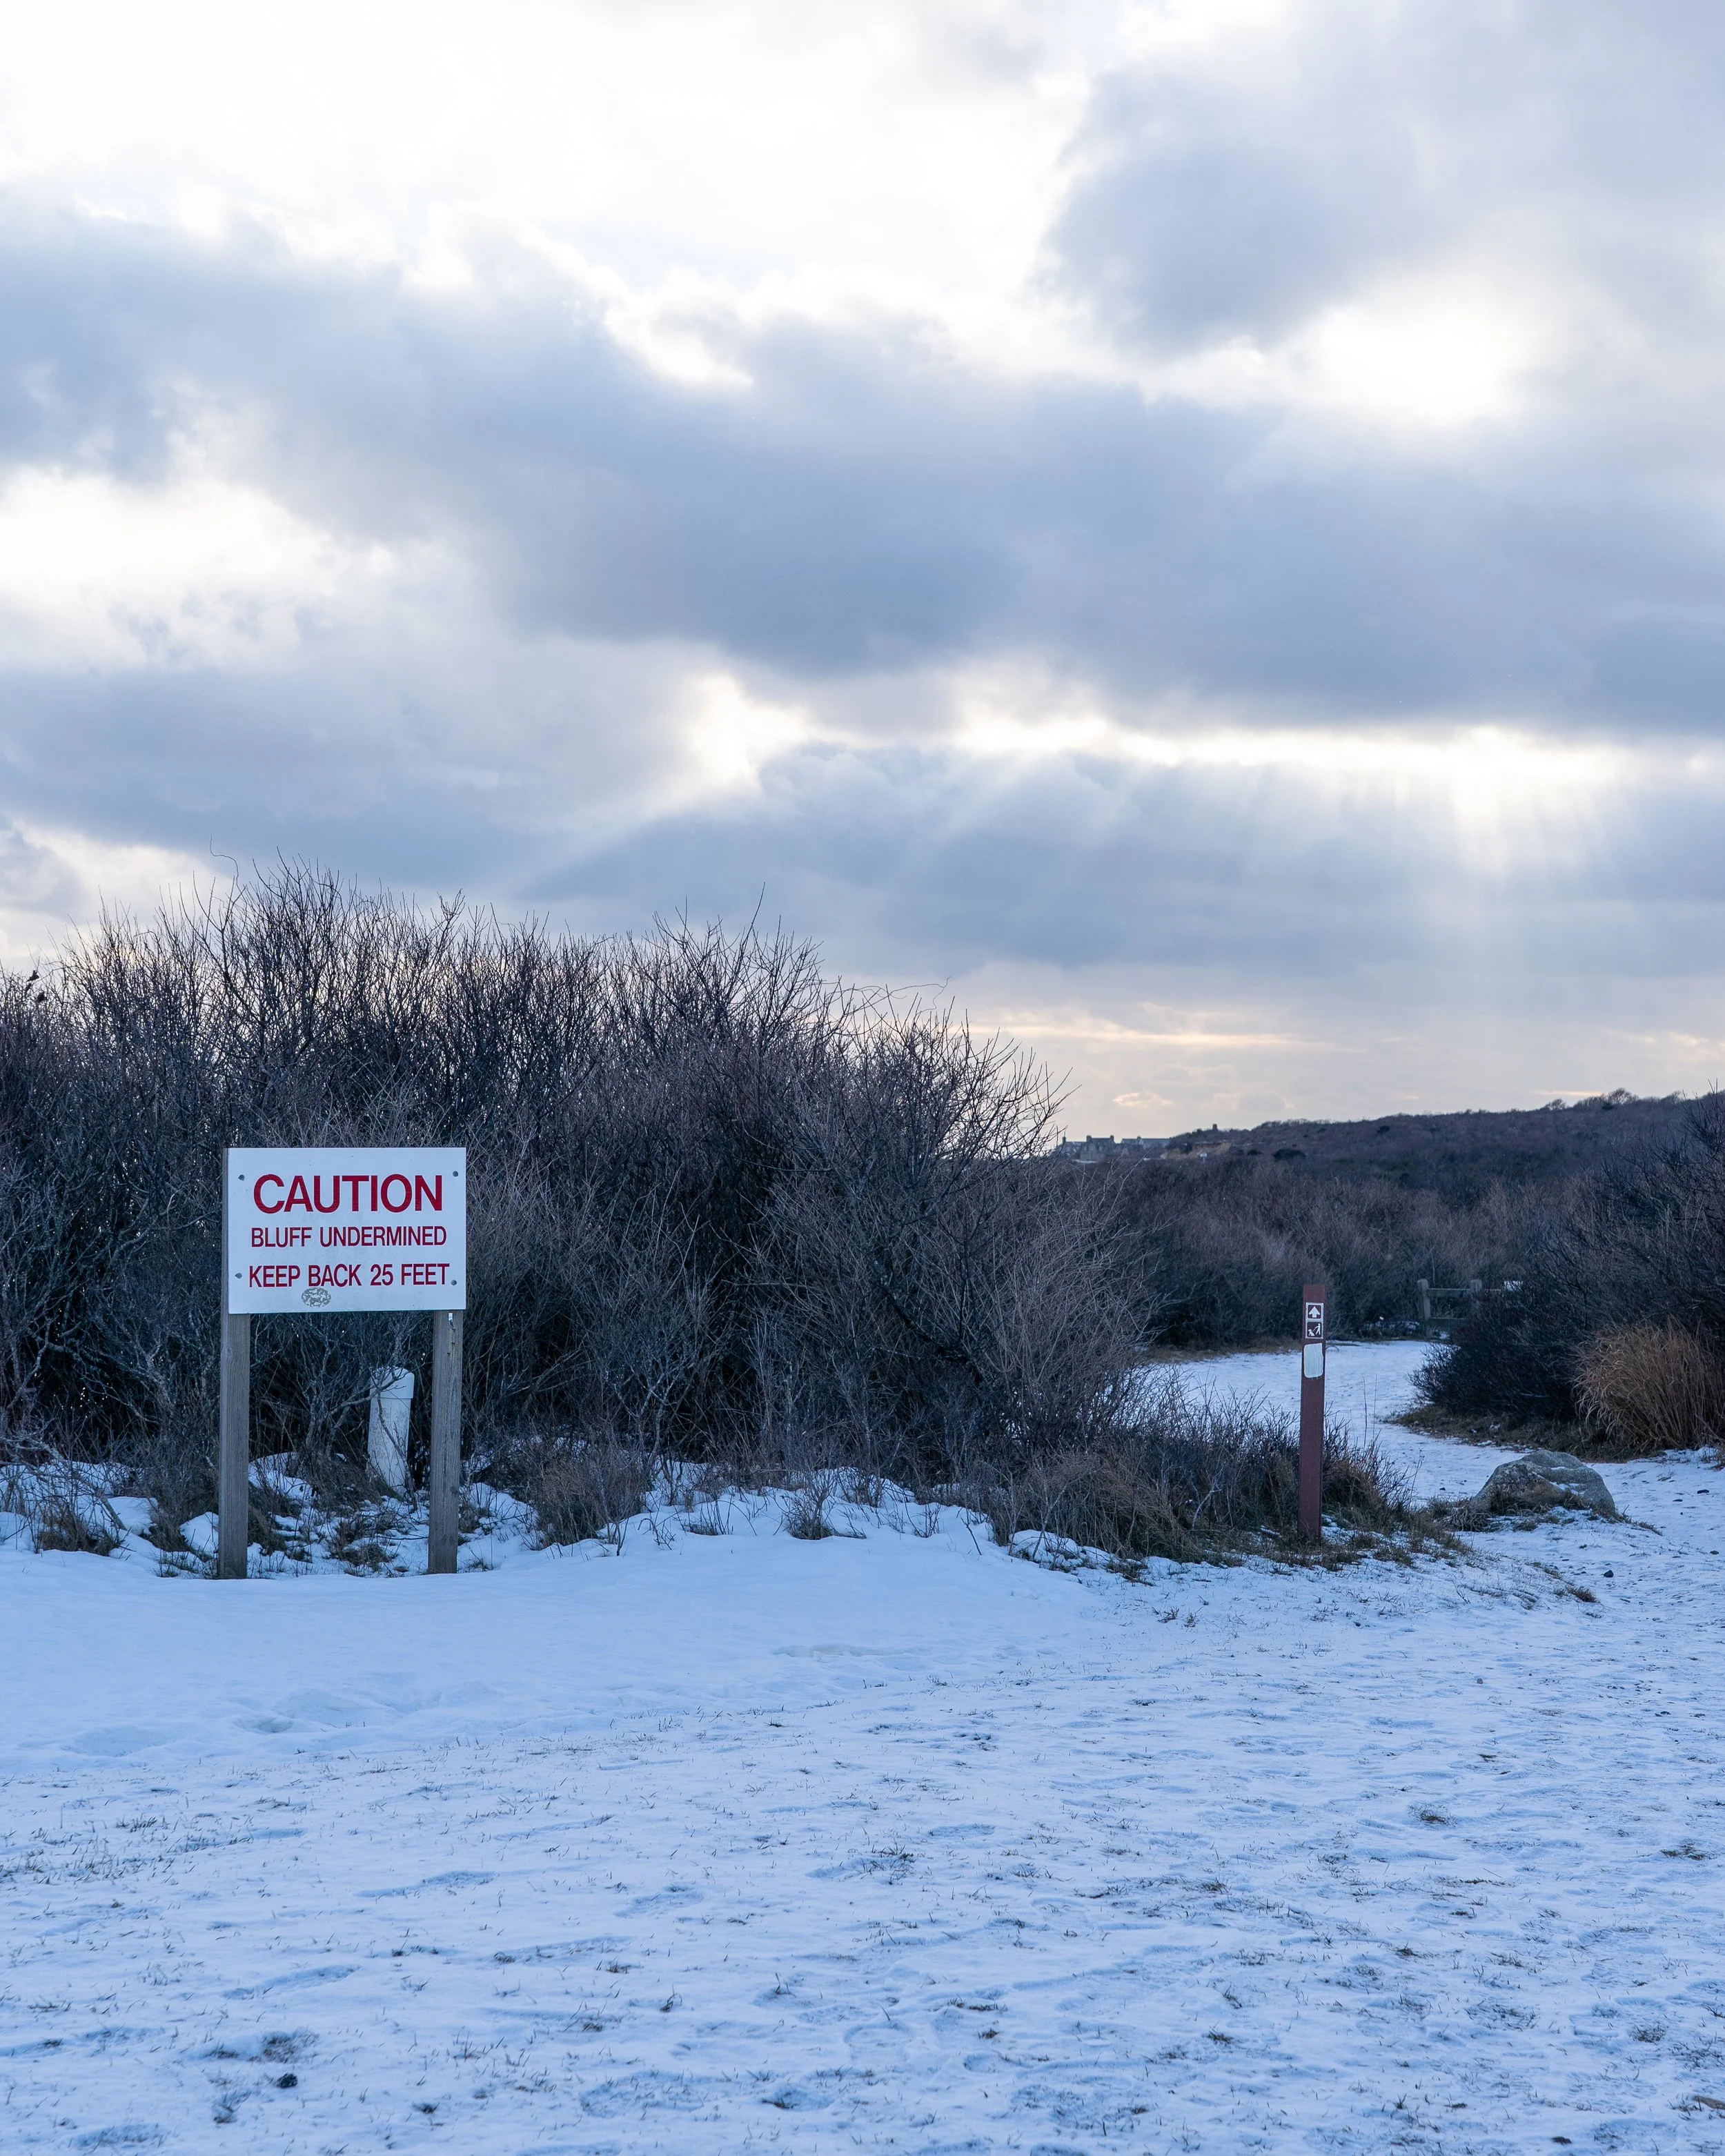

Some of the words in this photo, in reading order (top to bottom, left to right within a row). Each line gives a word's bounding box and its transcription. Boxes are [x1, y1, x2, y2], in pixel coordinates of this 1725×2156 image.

[254, 1174, 442, 1214] CAUTION
[251, 1227, 312, 1247] BLUFF
[320, 1226, 447, 1247] UNDERMINED
[249, 1265, 300, 1287] KEEP
[308, 1264, 362, 1287] BACK
[371, 1264, 393, 1285] 25
[402, 1263, 450, 1285] FEET
